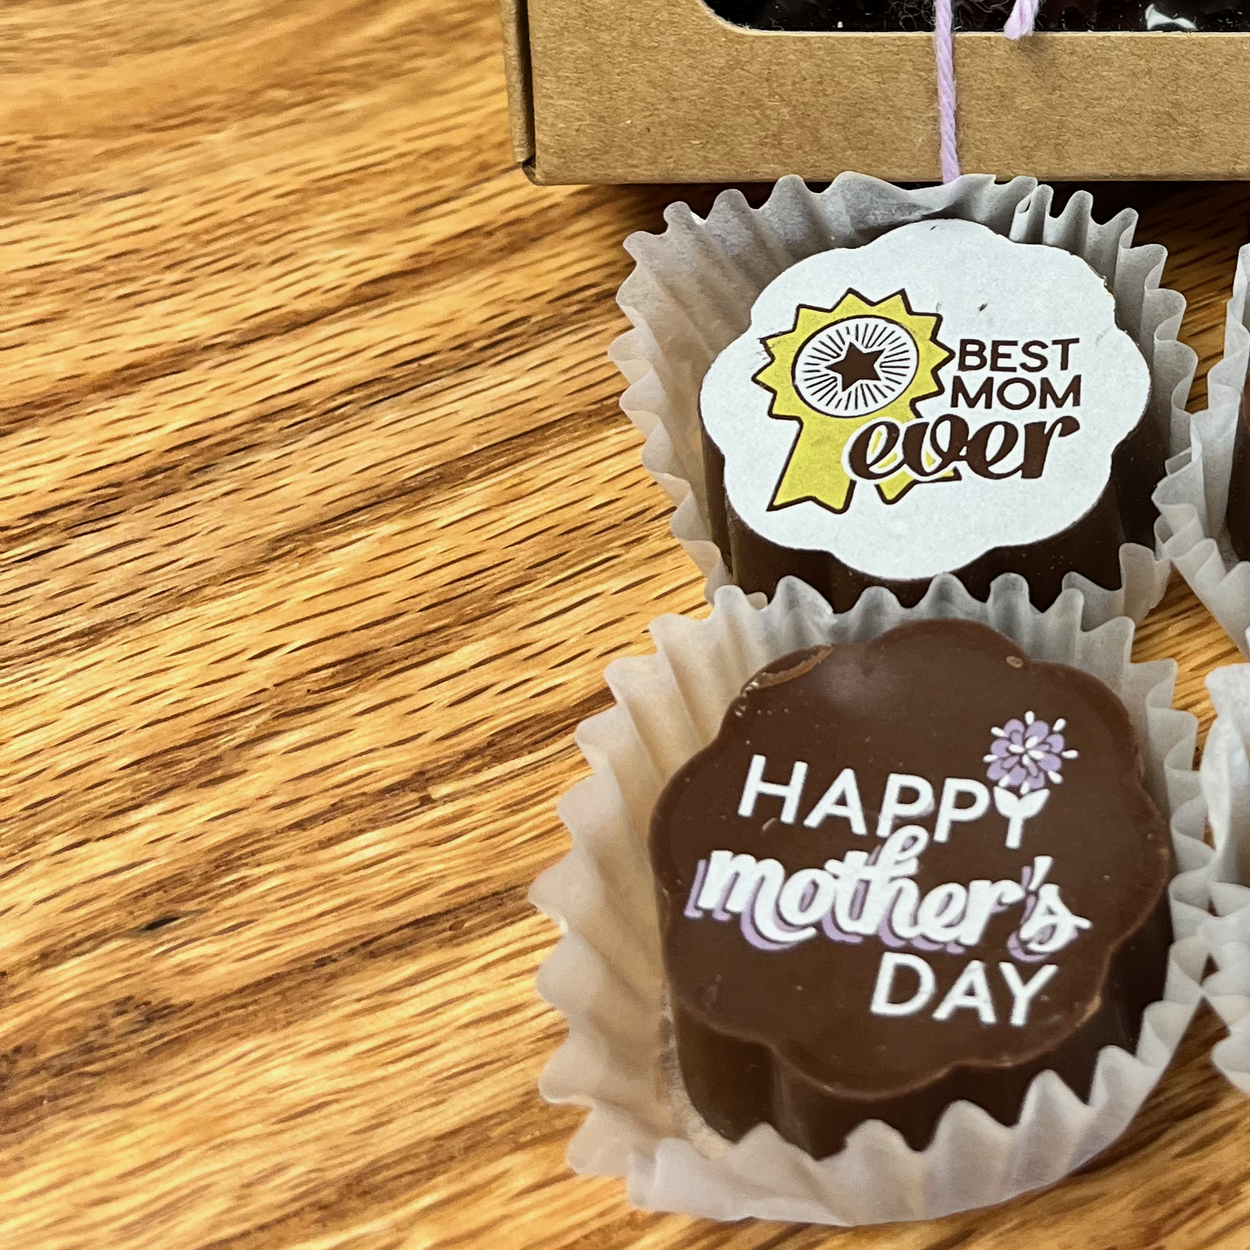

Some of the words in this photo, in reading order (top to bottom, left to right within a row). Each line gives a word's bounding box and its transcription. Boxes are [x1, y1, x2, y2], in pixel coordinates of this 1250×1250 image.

[957, 338, 1080, 371] BEST
[950, 375, 1081, 410] MOM
[848, 413, 1080, 481] ever
[738, 753, 1052, 849] HAPPY
[687, 825, 1092, 959] mother's
[870, 951, 1058, 1027] DAY
